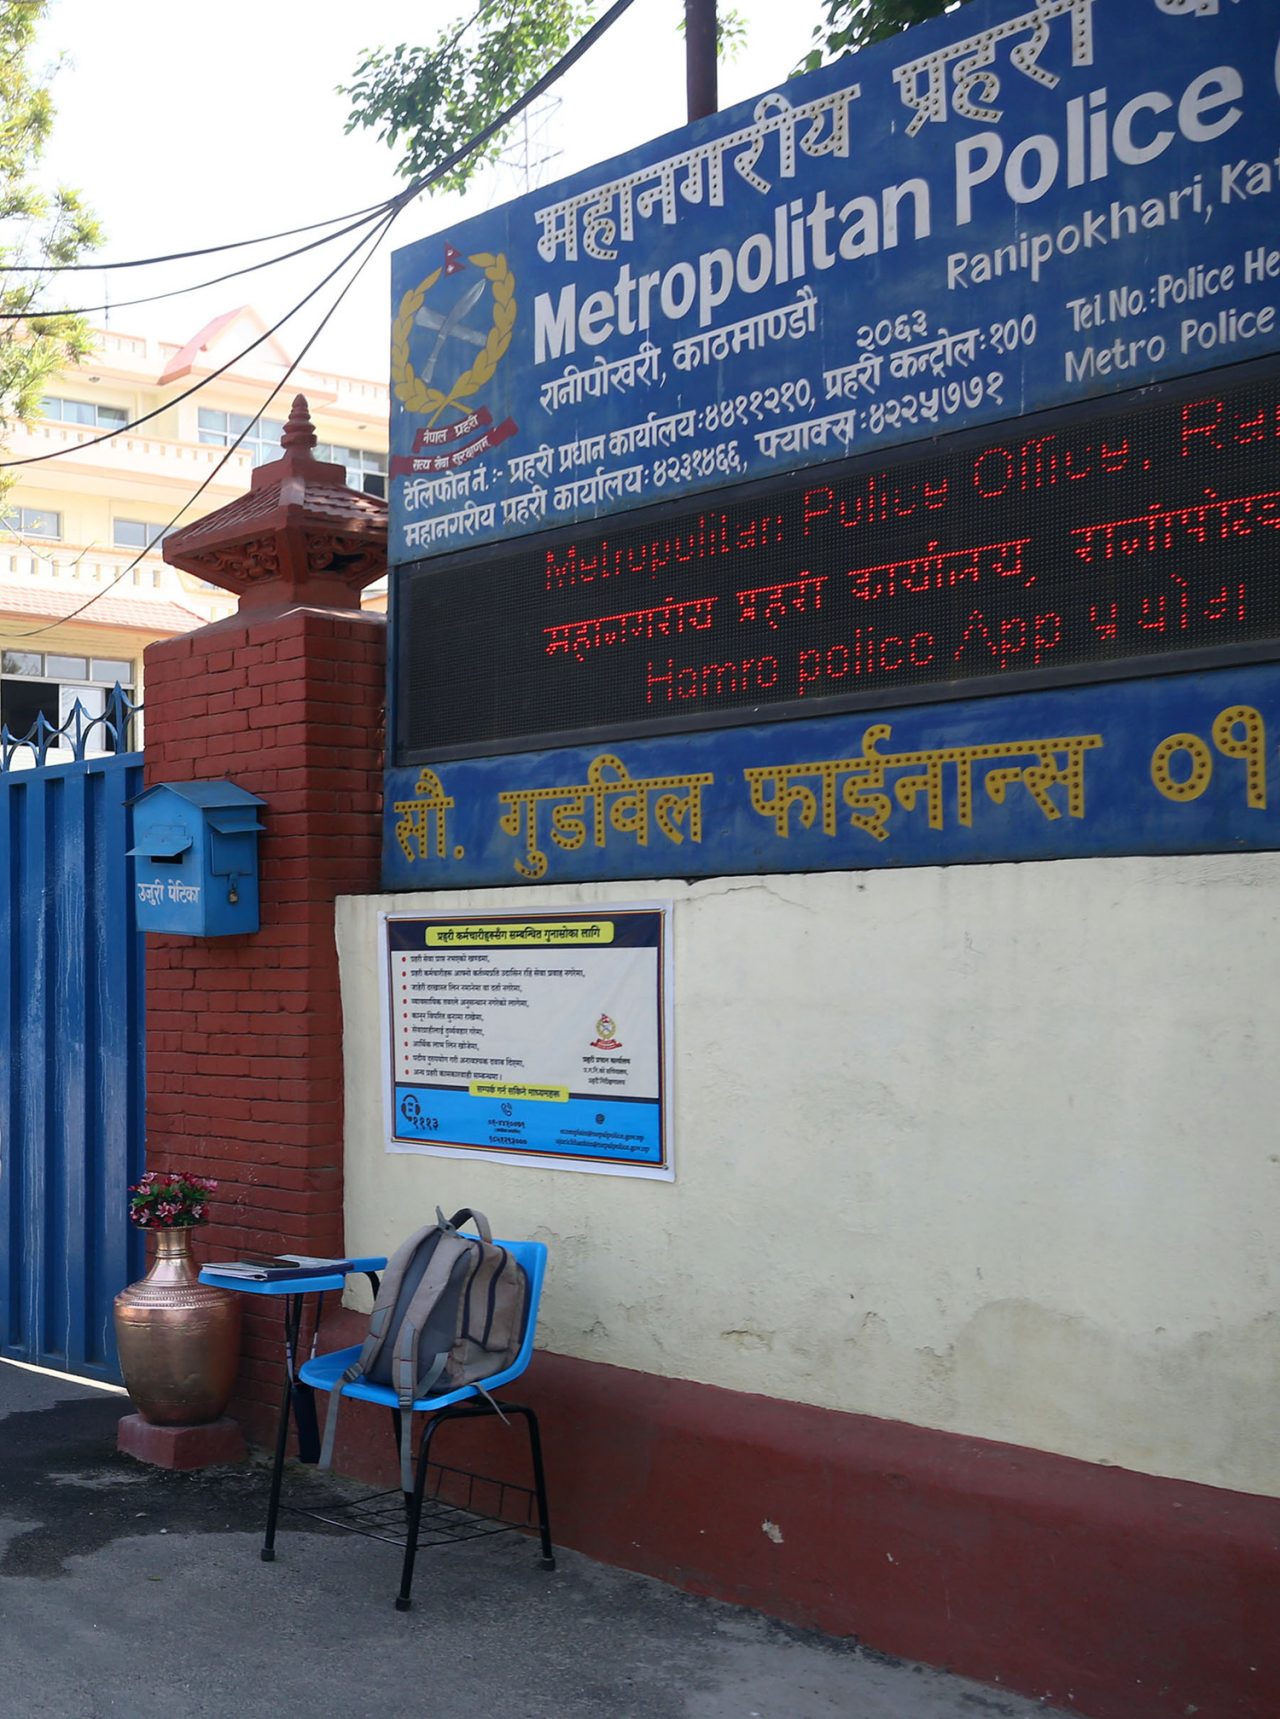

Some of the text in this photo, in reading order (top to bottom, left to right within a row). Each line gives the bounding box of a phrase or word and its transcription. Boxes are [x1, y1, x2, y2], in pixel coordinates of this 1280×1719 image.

[534, 83, 862, 262] महानगरीय
[892, 0, 1096, 138] प्रहरी
[534, 66, 1244, 365] Metropolitan Police
[947, 148, 1280, 290] Ranipokhari, Ka
[673, 285, 818, 373] काठमाण्डौ
[856, 309, 928, 351] २०६३
[1065, 306, 1276, 382] Metro Police
[508, 446, 553, 484] प्रहरी
[559, 433, 605, 469] प्रधान
[823, 353, 883, 400] प्रहरी
[404, 503, 496, 548] महानगरीय
[501, 485, 547, 526] प्रहरी
[736, 570, 829, 630] प्रहरी
[646, 654, 779, 704] Hamro
[799, 626, 935, 696] police
[954, 610, 1062, 669] App
[498, 754, 714, 879] गुडविल
[437, 929, 454, 942] प्रहरी
[581, 925, 601, 938] लागि
